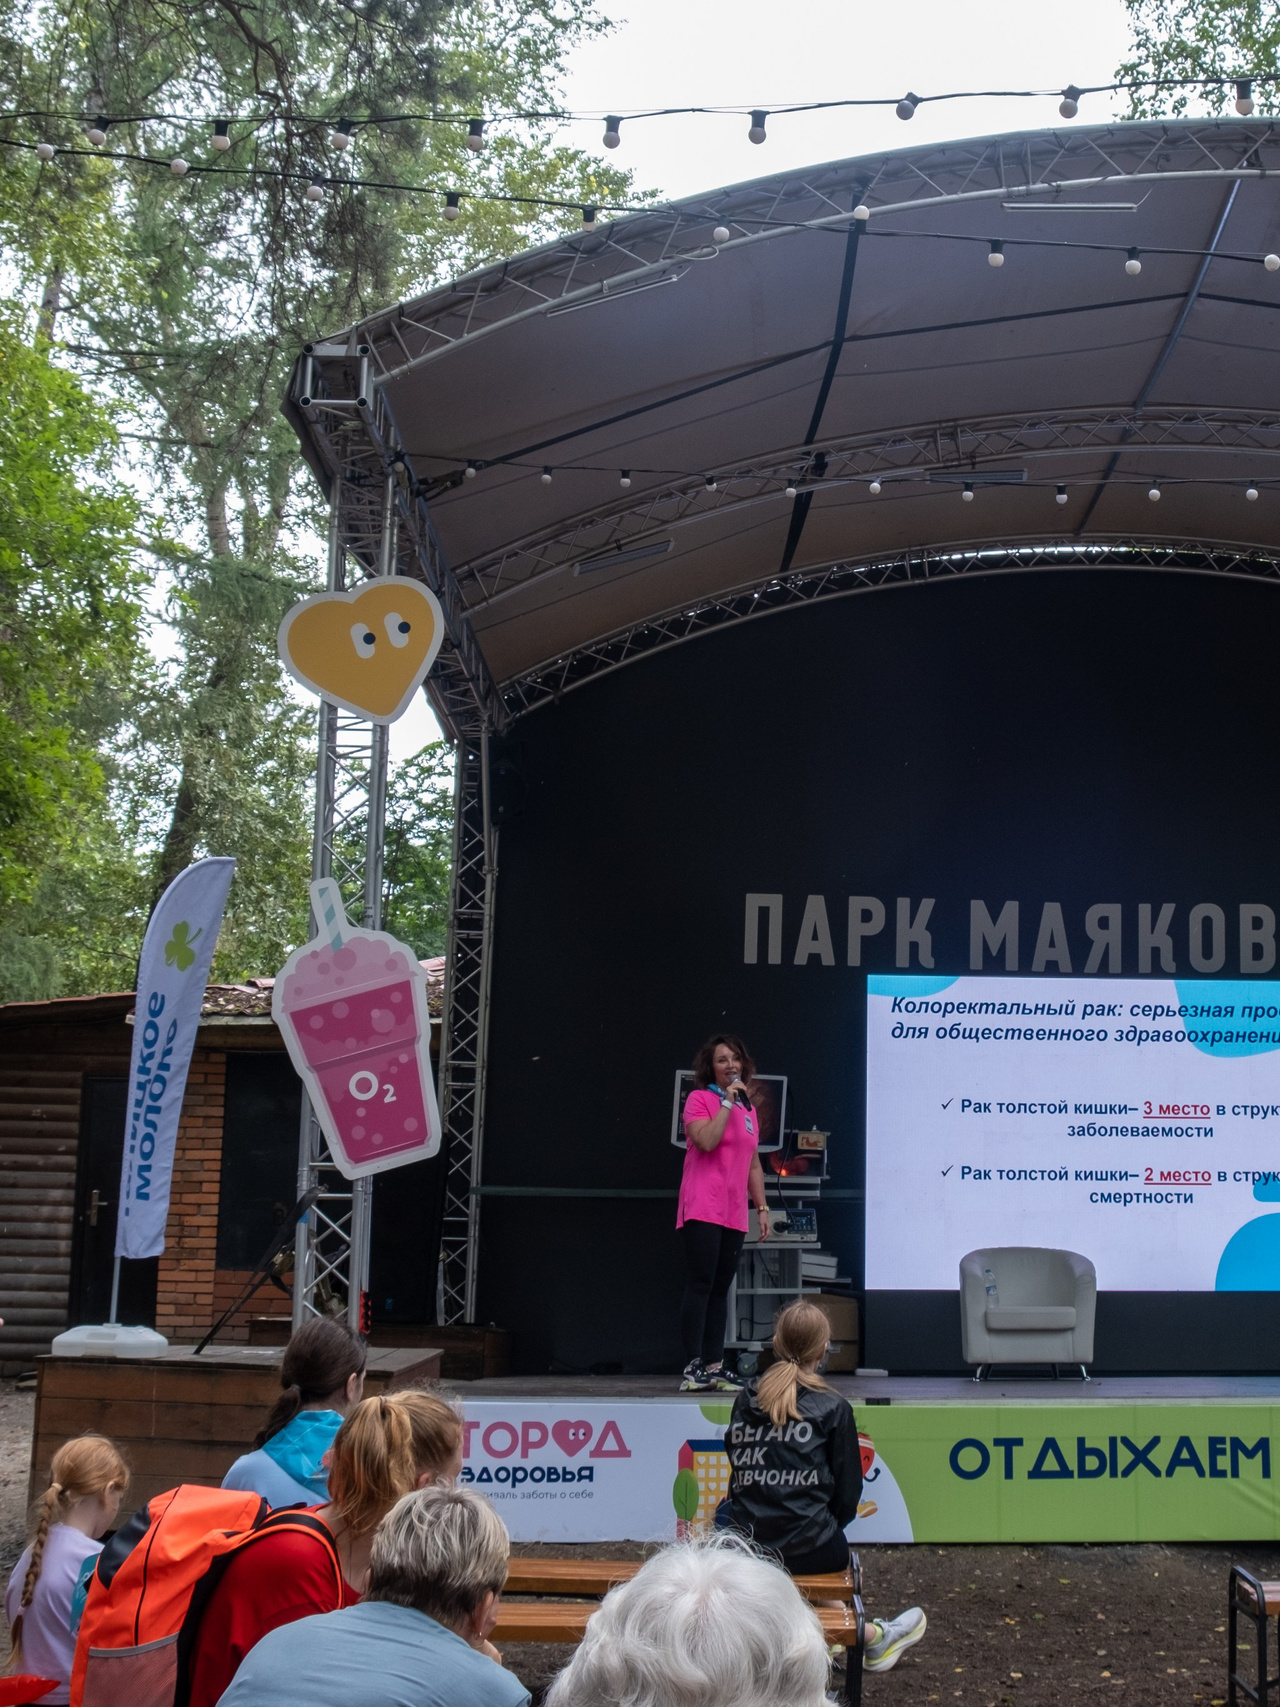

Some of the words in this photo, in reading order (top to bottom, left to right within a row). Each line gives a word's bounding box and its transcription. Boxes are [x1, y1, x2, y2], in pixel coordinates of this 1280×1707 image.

[743, 892, 936, 970] ПАРК
[890, 996, 1077, 1018] Колоректальный
[1081, 1002, 1124, 1021] рак:
[1129, 1003, 1236, 1022] серьезная
[890, 1021, 930, 1040] для
[935, 1022, 1109, 1043] общественного
[960, 1099, 993, 1114] Рак
[996, 1099, 1069, 1115] толстой
[1143, 1100, 1154, 1116] 3
[1158, 1103, 1211, 1117] место
[1216, 1104, 1227, 1116] в
[1066, 1122, 1214, 1138] заболеваемости
[960, 1165, 993, 1181] Рак
[996, 1166, 1069, 1181] толстой
[1143, 1167, 1154, 1182] 2
[1159, 1170, 1212, 1183] место
[1217, 1171, 1228, 1182] в
[1089, 1191, 1194, 1207] смертности
[731, 1446, 768, 1467] КАК
[948, 1435, 1272, 1481] ОТДЫХАЕМ
[520, 1489, 557, 1500] заботы
[559, 1491, 567, 1500] о
[568, 1489, 594, 1500] себе
